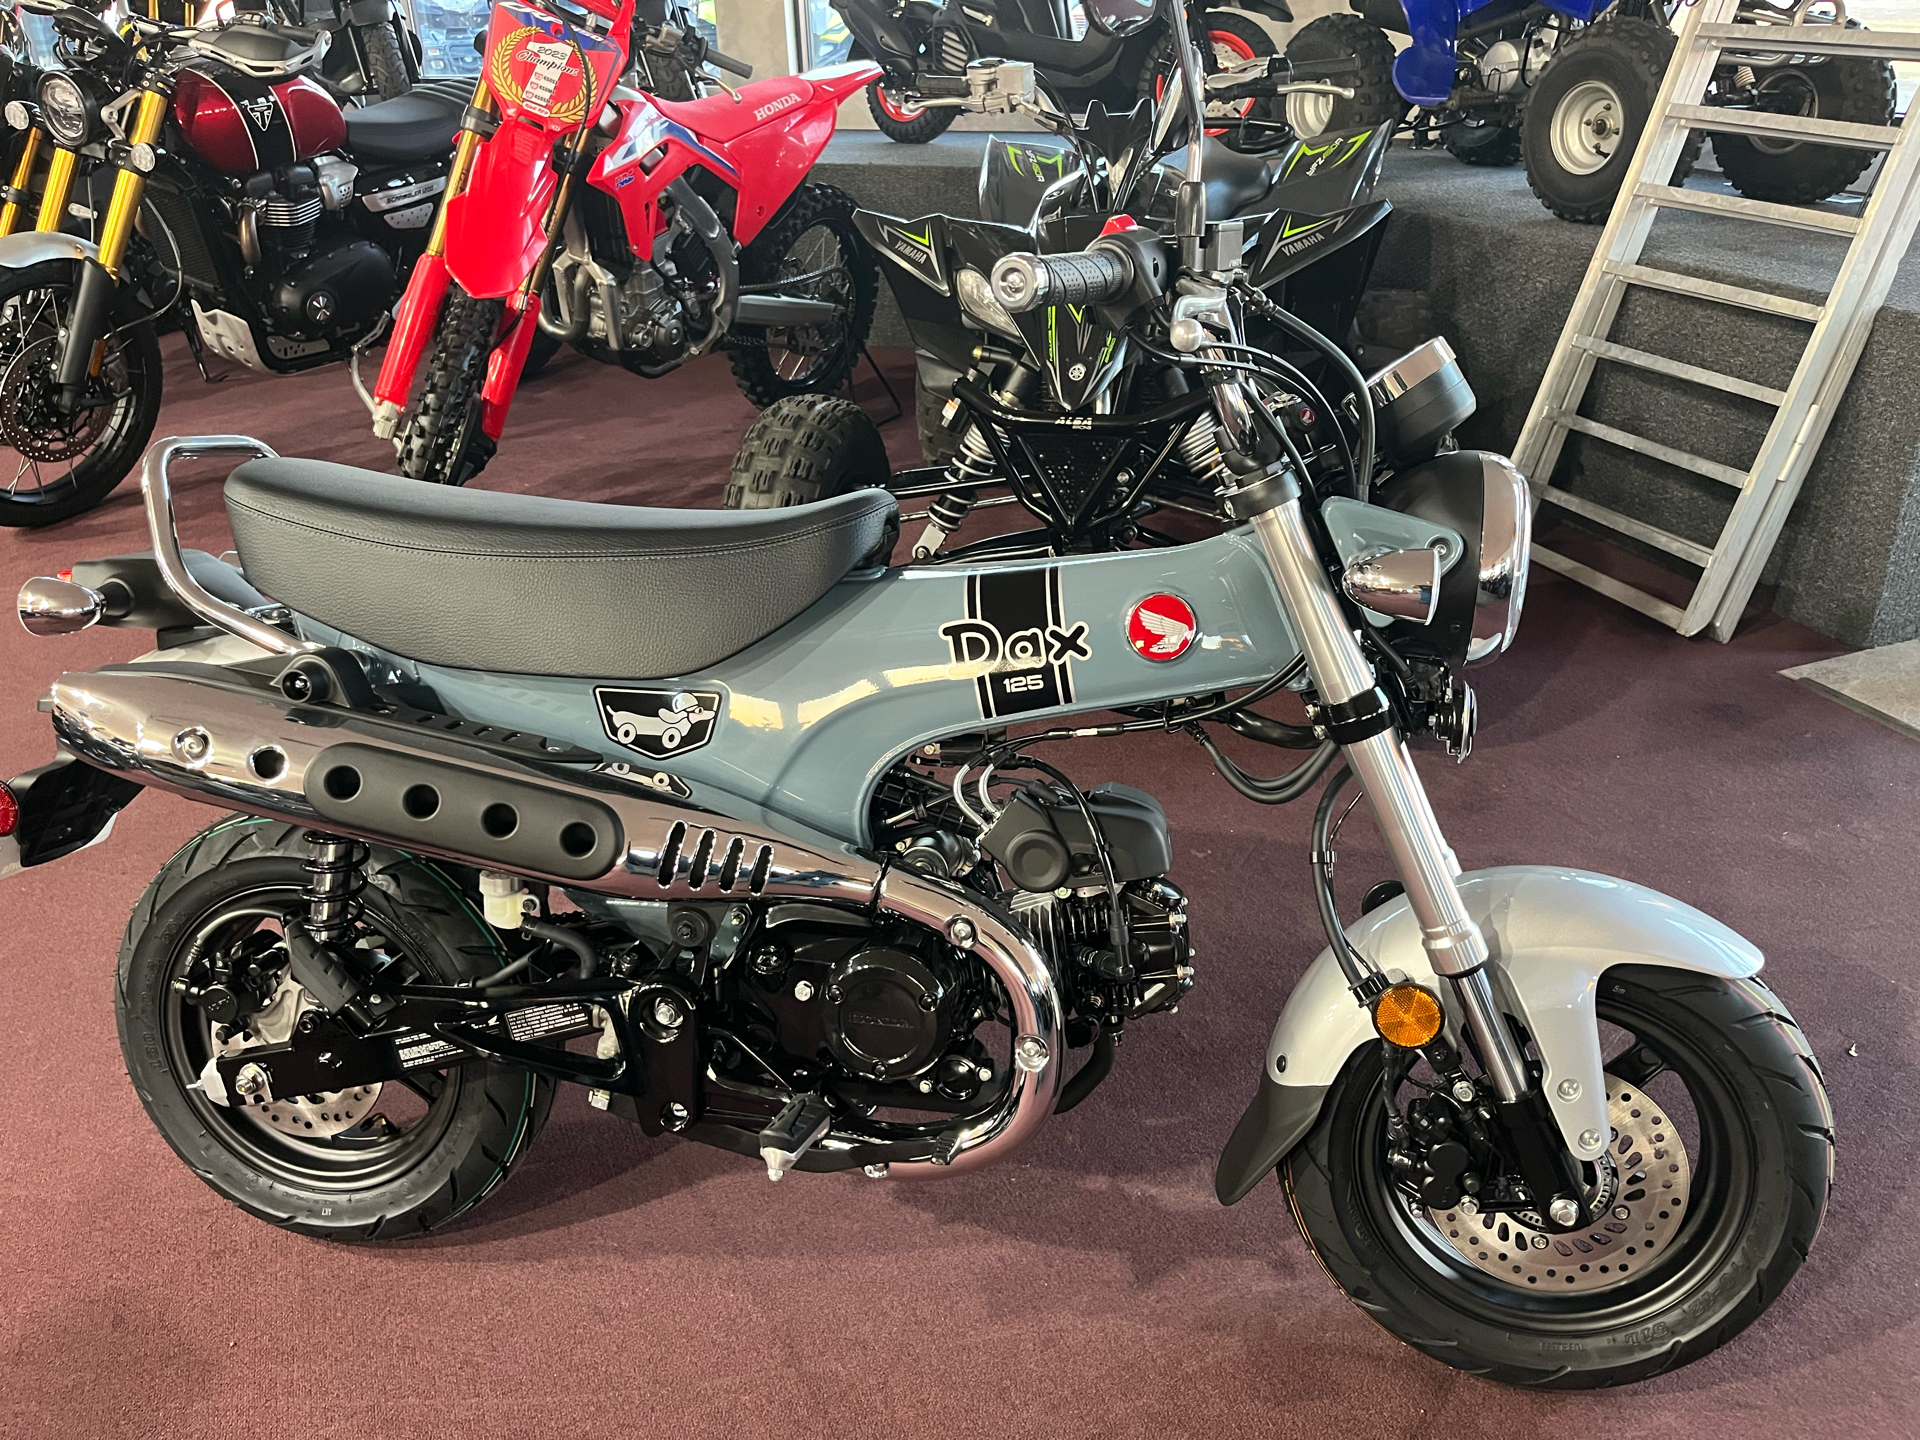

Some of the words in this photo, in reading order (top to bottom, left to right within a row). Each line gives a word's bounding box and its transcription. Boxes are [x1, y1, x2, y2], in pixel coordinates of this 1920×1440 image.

[516, 50, 579, 76] Champions
[537, 46, 568, 61] 2023
[753, 93, 802, 121] HONDA
[1305, 137, 1344, 177] YFZ450R
[895, 240, 927, 265] YAMAHA
[1281, 232, 1325, 257] YAMAHA
[938, 619, 1093, 680] Dax
[1003, 674, 1045, 693] 125
